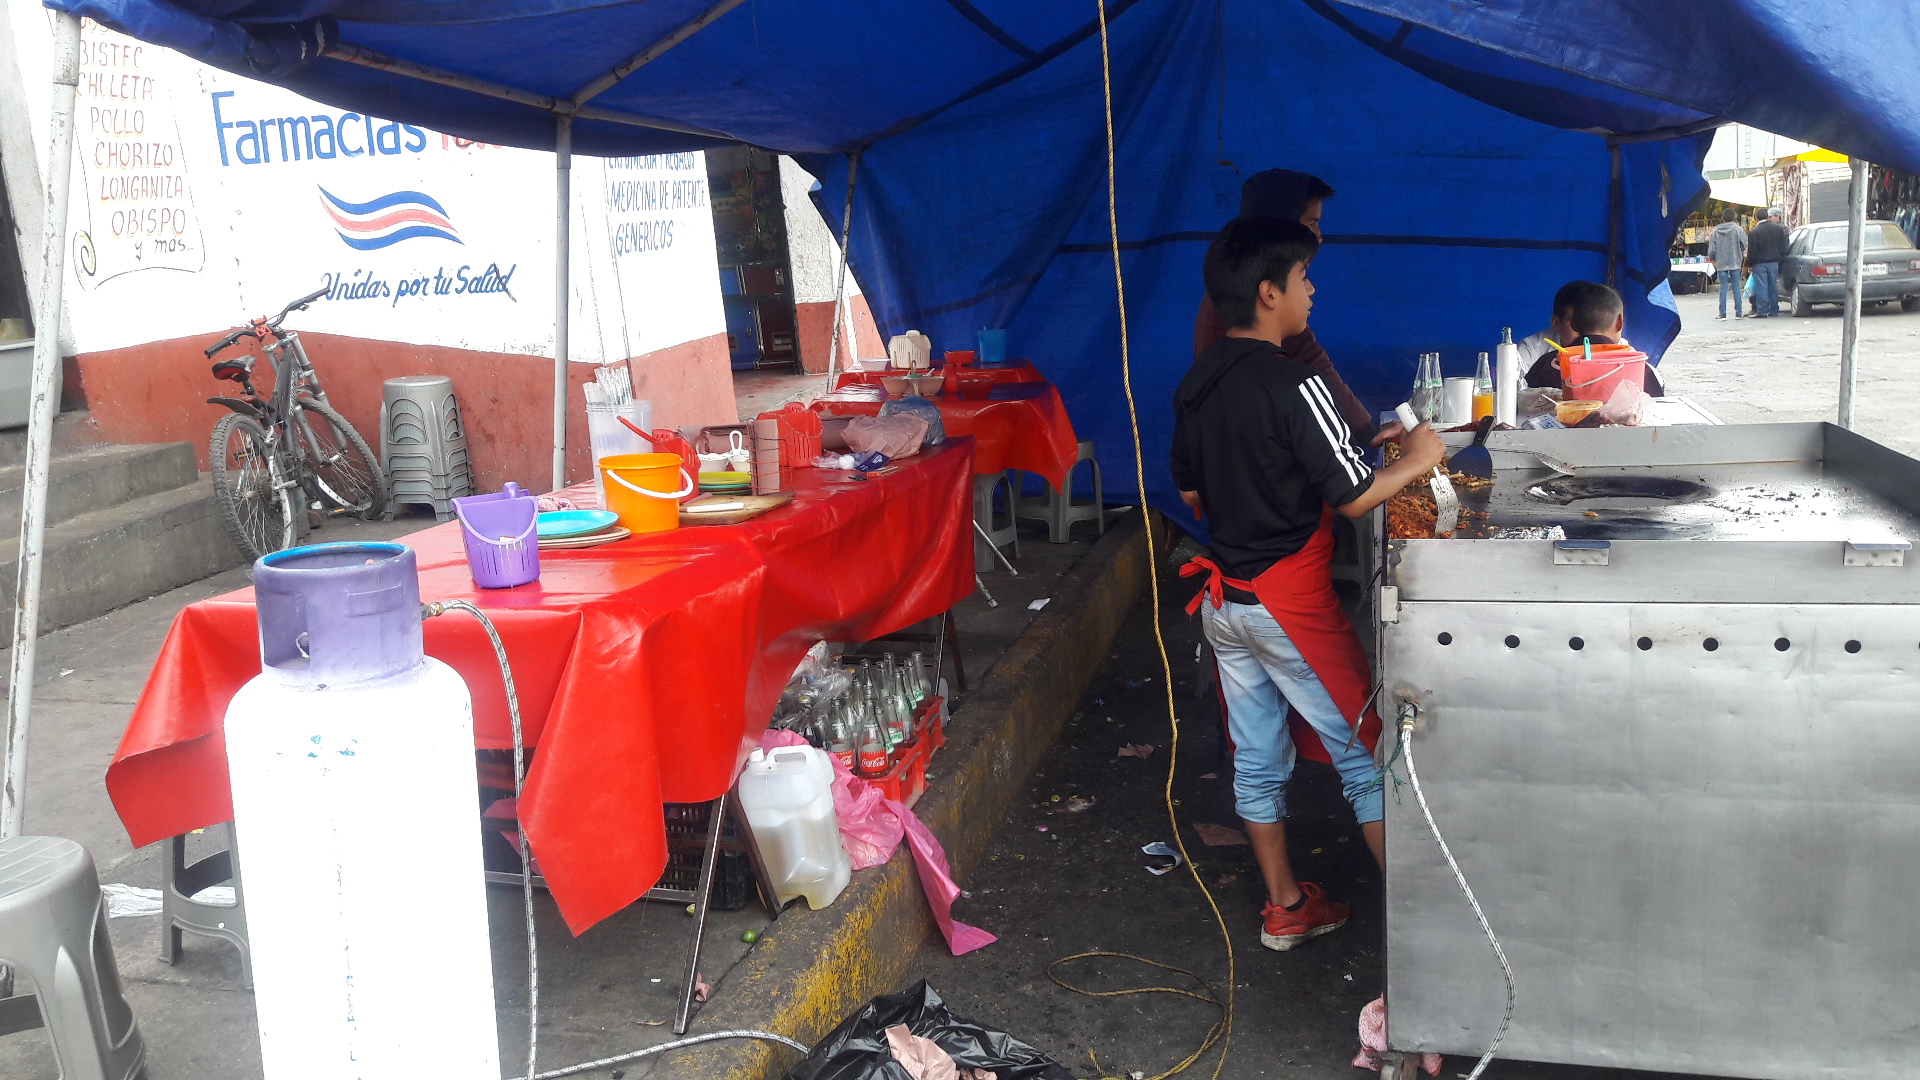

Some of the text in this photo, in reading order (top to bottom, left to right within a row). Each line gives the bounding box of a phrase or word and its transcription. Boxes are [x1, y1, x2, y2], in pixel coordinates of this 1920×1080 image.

[80, 40, 143, 68] BISTEC
[91, 107, 144, 134] POLLO
[211, 90, 427, 166] Farmacias
[96, 142, 173, 168] CHORIZO
[101, 176, 183, 200] LONGANIZA
[610, 180, 705, 212] MEDICINA DE PATENTE
[112, 208, 186, 236] OBISPO
[616, 219, 674, 257] GENERICOS
[322, 263, 517, 308] Unidas por tu Salud
